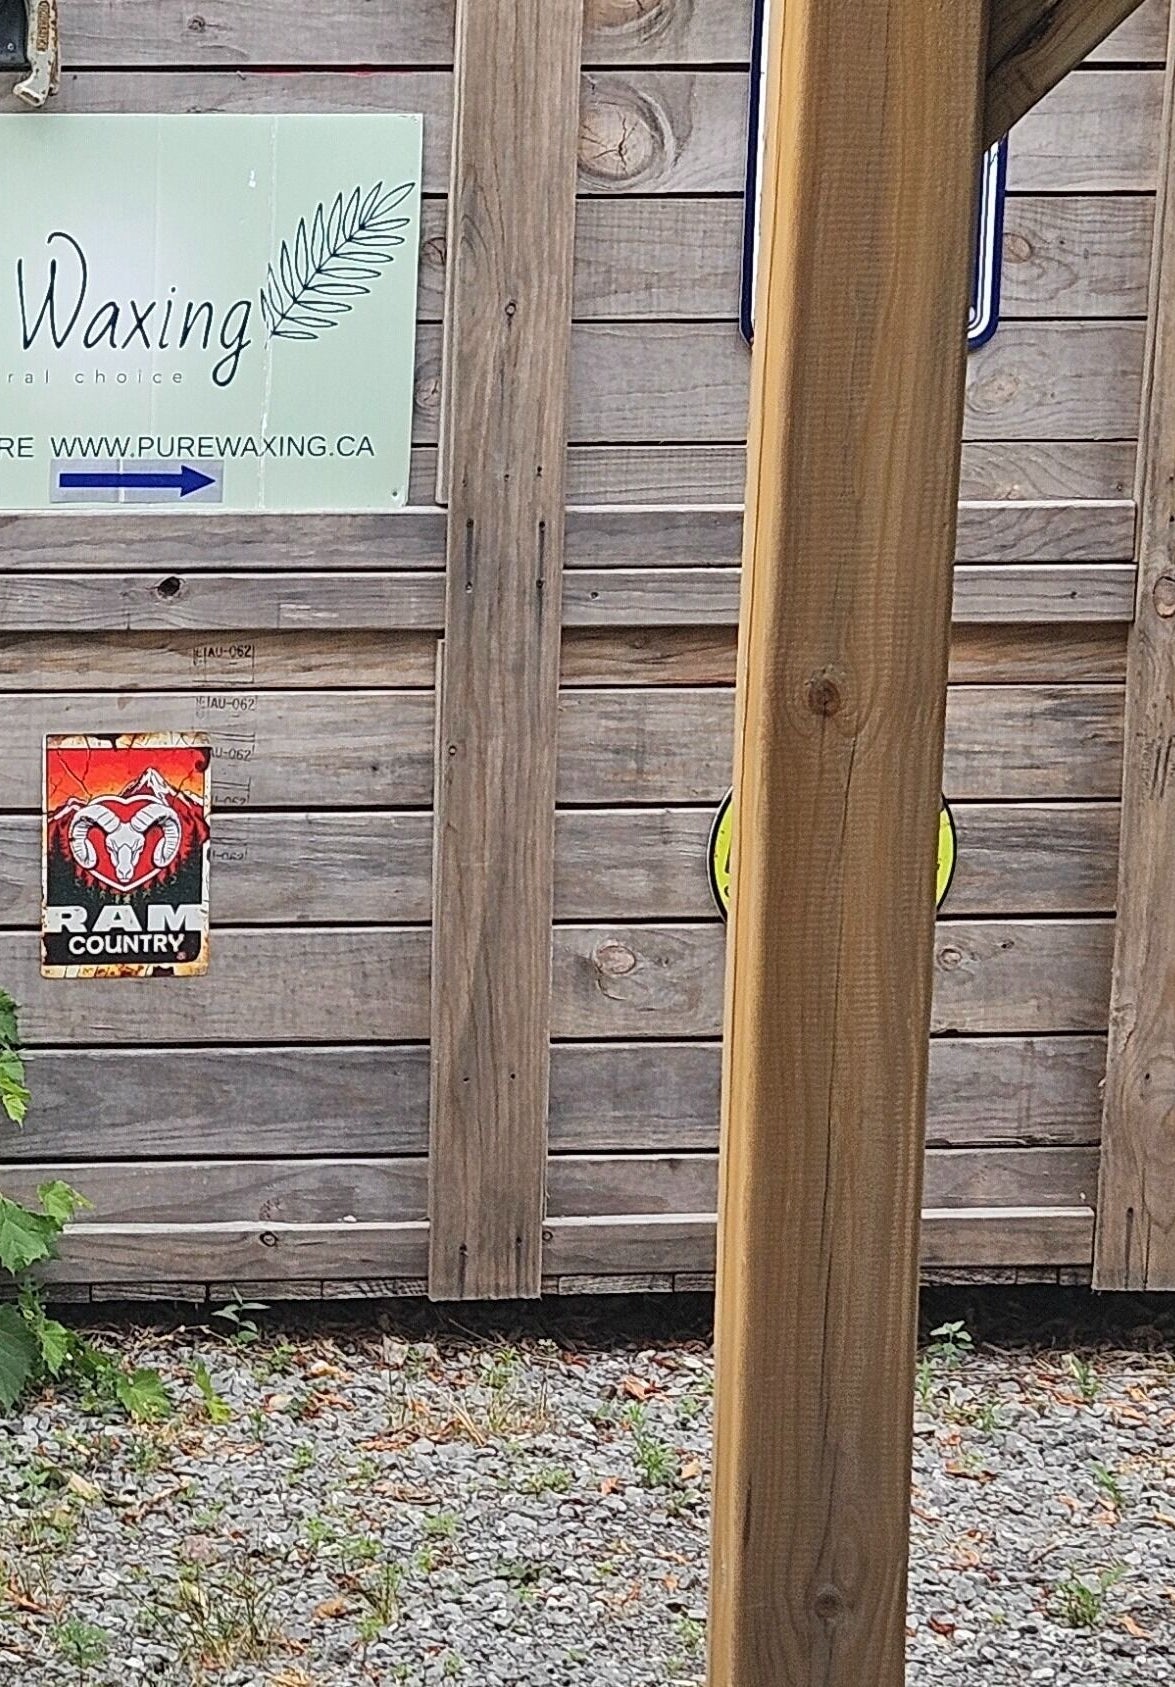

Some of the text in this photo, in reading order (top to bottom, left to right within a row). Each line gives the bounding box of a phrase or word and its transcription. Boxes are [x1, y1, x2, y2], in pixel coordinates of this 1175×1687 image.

[16, 231, 252, 387] Waxing
[74, 368, 183, 384] choice
[50, 434, 375, 458] WWW.PUREWAXING.CA
[46, 904, 202, 933] RAM
[68, 933, 185, 955] COUNTRY
